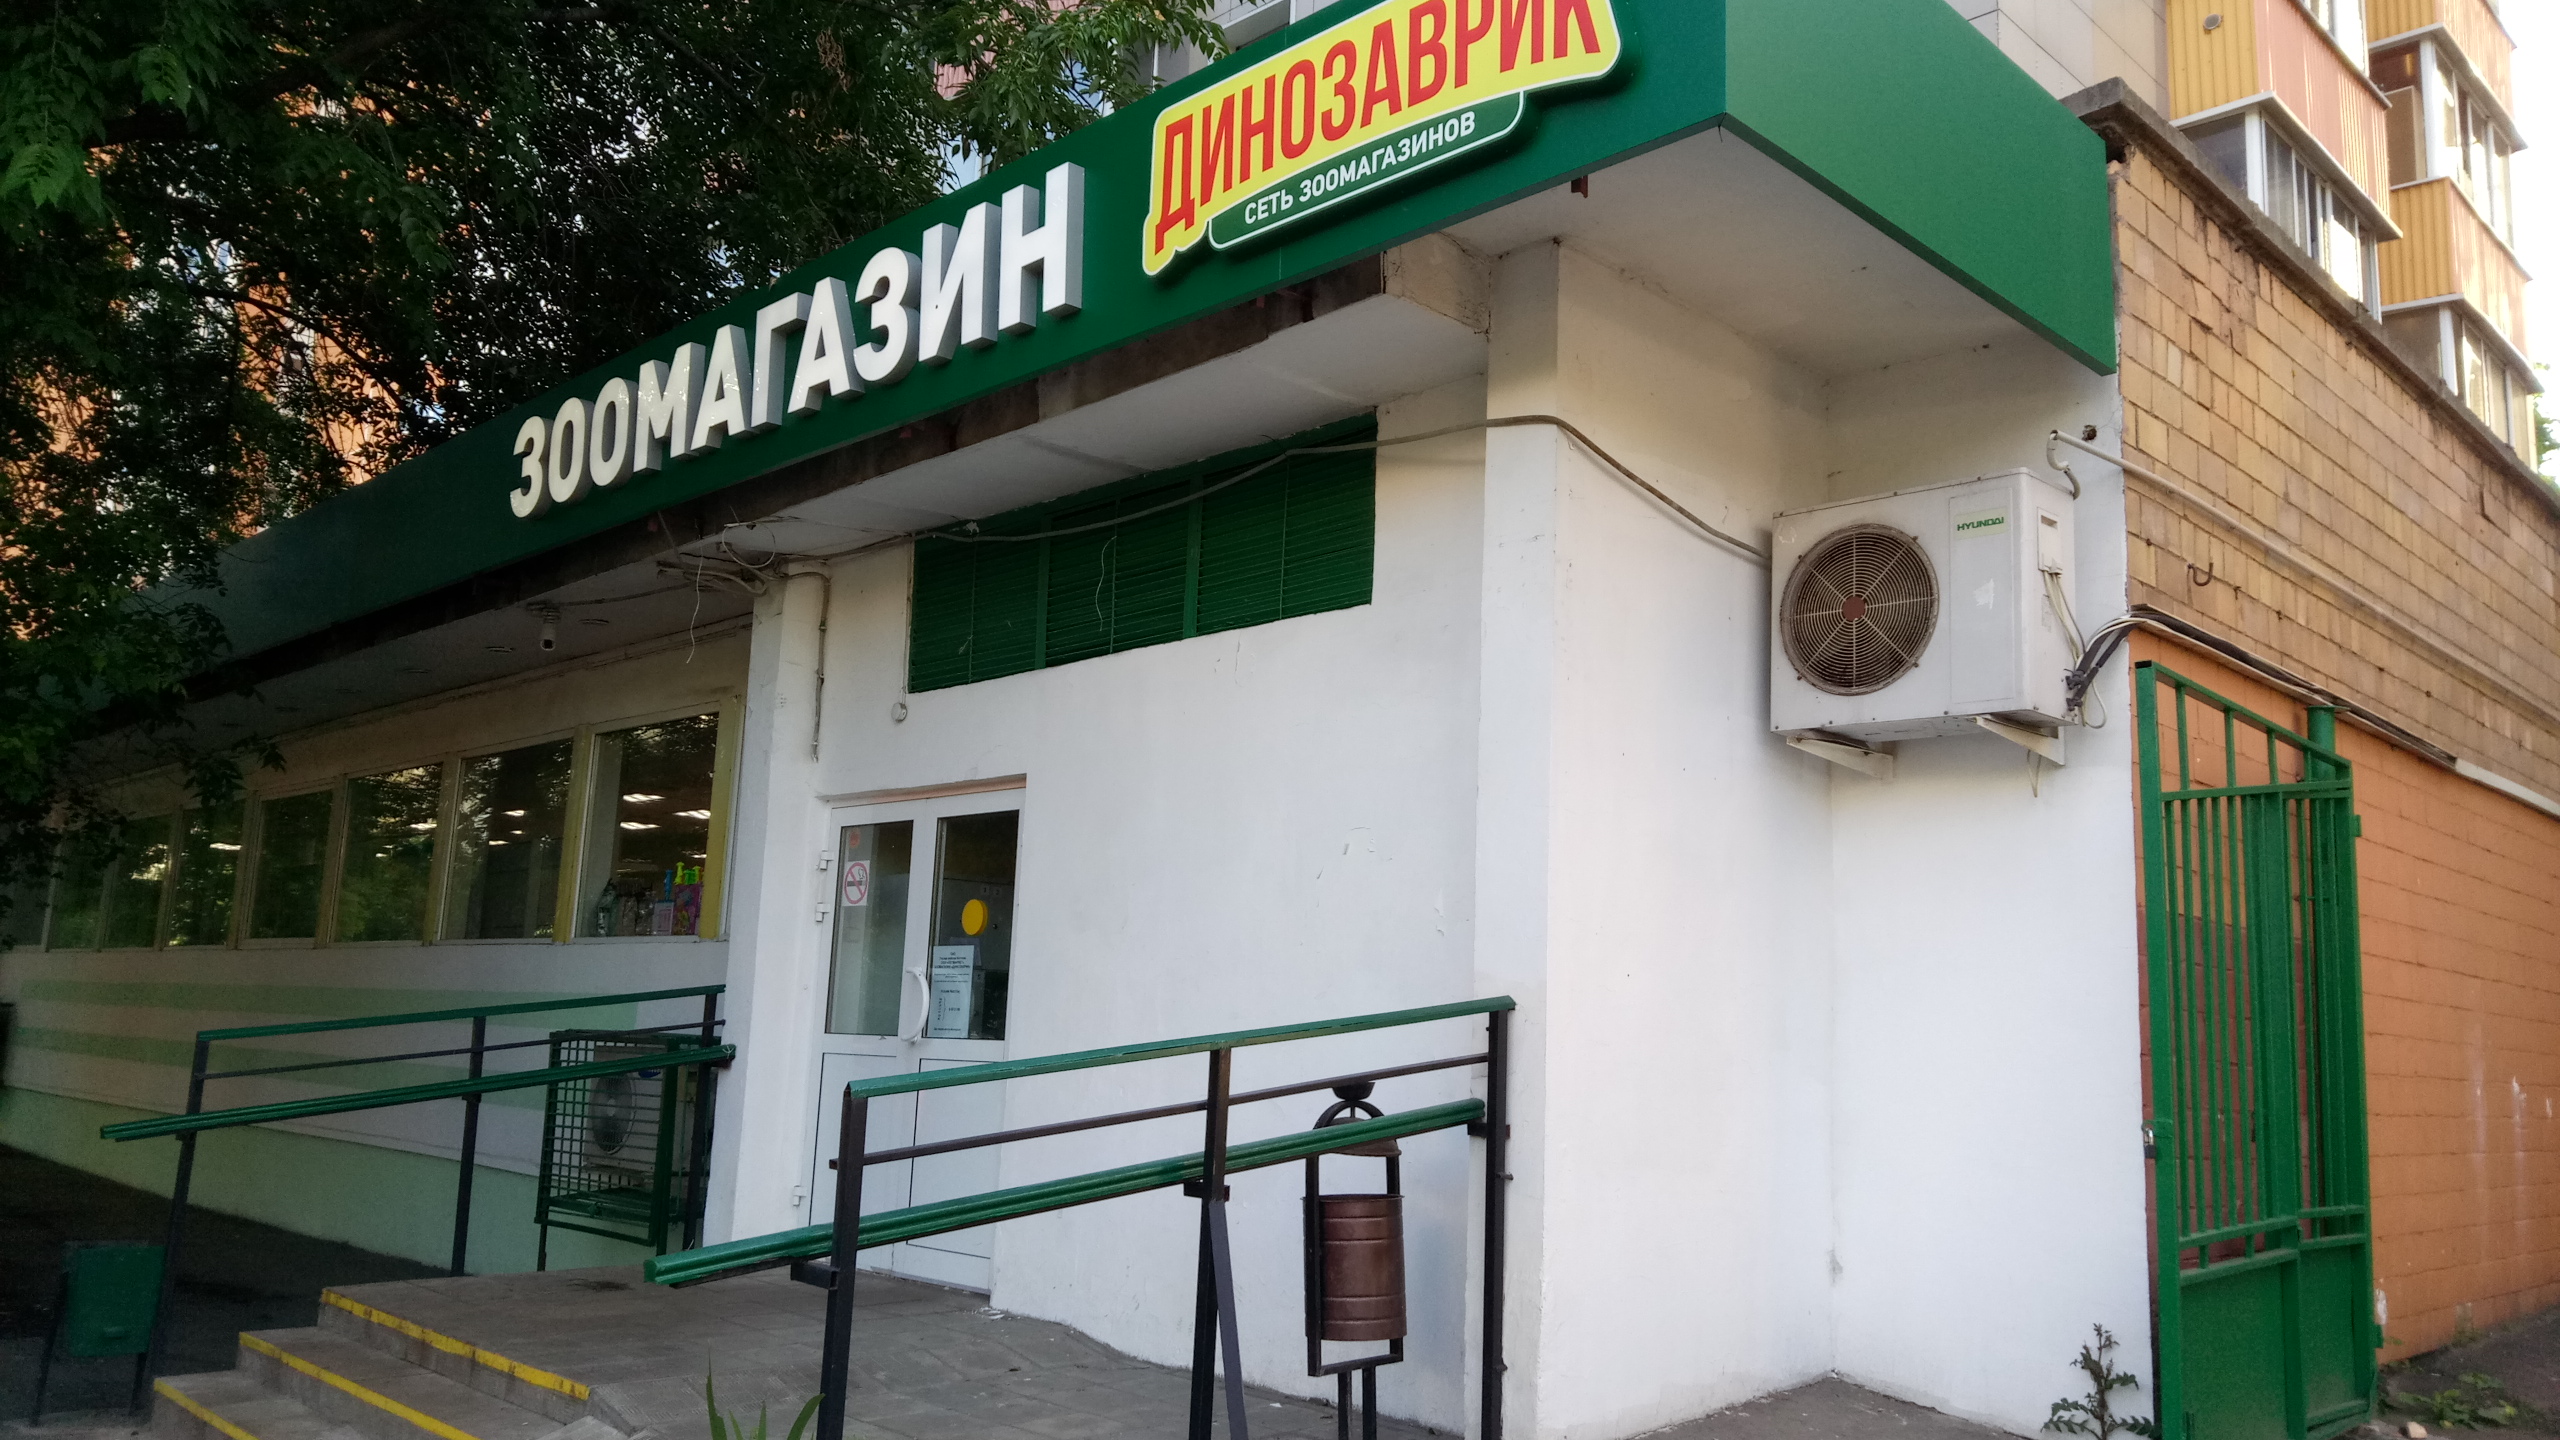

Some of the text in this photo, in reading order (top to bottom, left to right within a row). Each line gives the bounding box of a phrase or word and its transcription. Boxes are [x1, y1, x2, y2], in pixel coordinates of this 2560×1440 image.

[1154, 0, 1601, 256] ДИНОЗАВРИК
[1244, 111, 1476, 225] СЕТЬ ЗООМАГАЗИНОВ
[510, 162, 1084, 519] ЗООМАГАЗИН
[1957, 517, 2004, 531] HYUNDAI
